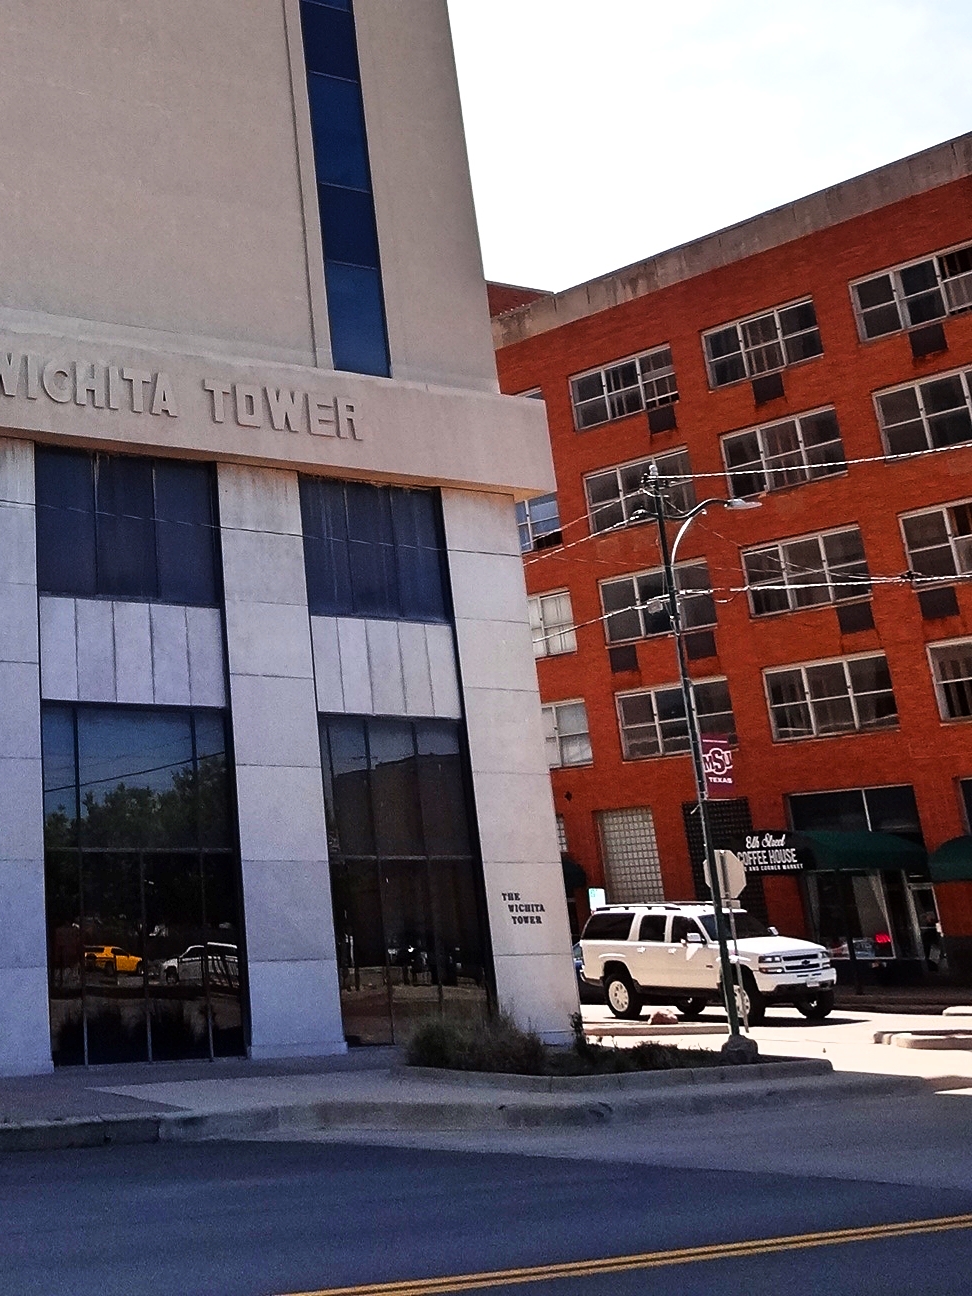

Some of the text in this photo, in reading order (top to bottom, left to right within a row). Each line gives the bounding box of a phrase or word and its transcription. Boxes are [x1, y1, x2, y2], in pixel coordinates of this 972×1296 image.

[203, 378, 364, 442] TOWER
[702, 747, 733, 774] MSU
[708, 776, 733, 784] TEXAS
[761, 833, 786, 848] Street
[737, 848, 798, 866] COFFEE HOUSE
[501, 892, 521, 901] THE
[508, 903, 546, 913] WICHITA
[511, 915, 543, 925] TOWER
